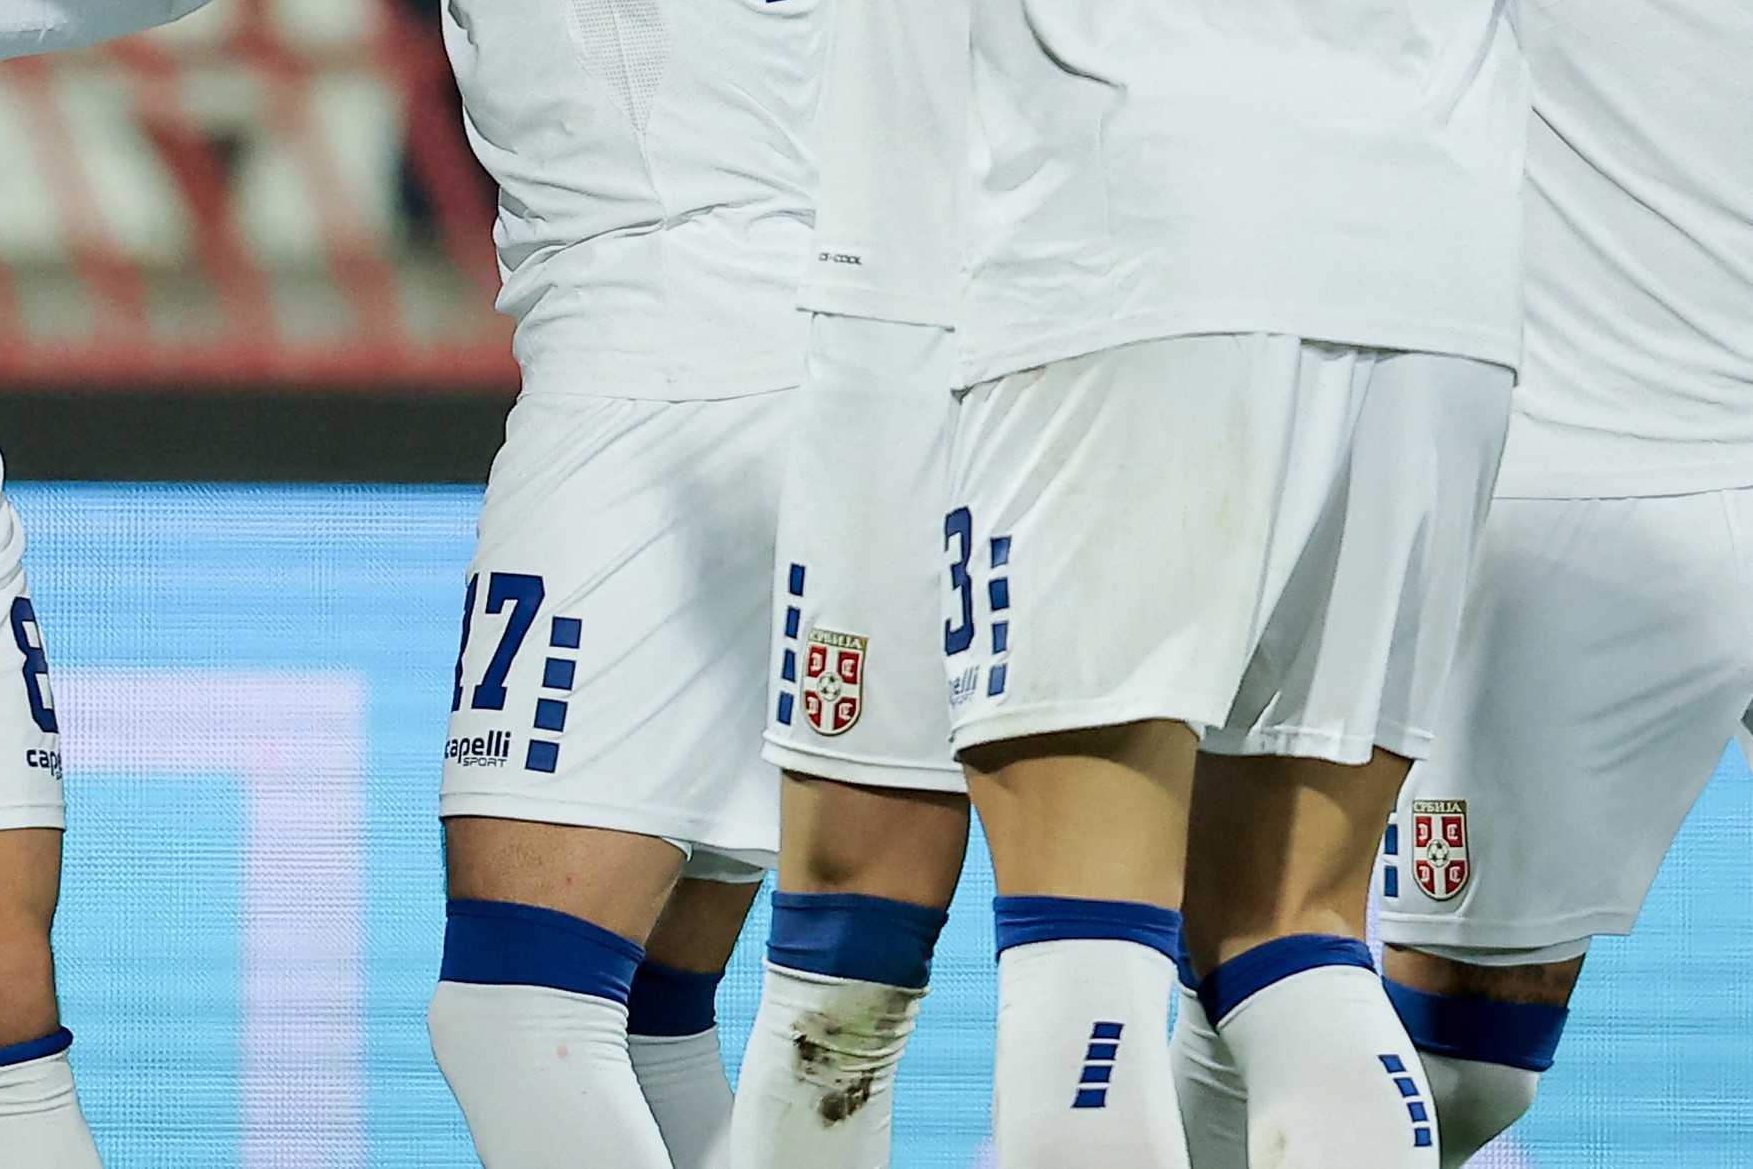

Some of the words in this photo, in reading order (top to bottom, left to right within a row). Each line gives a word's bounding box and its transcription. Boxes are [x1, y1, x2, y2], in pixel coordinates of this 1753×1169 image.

[944, 505, 975, 657] 3
[9, 596, 60, 734] 8
[462, 757, 508, 768] SPORT
[1413, 801, 1463, 813] СРБИЈА
